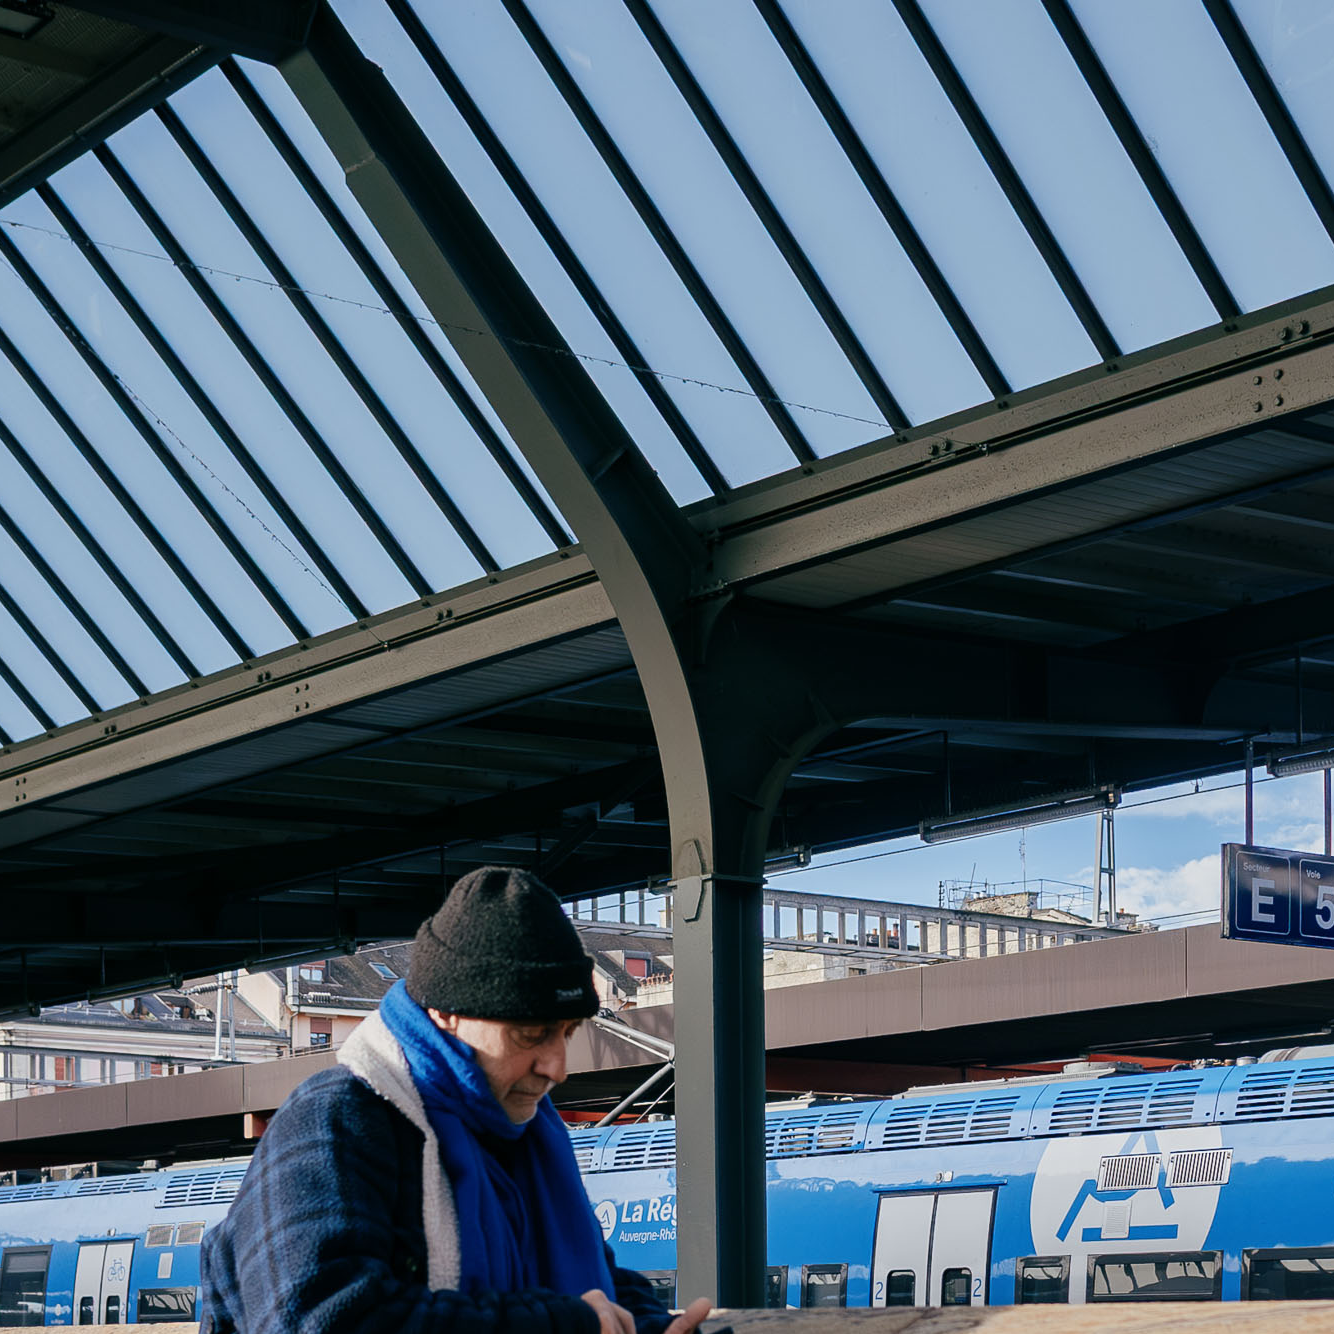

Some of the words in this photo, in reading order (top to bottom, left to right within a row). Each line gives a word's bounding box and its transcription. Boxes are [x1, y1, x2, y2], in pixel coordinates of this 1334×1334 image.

[1243, 862, 1271, 873] Secteur
[1306, 869, 1321, 880] Voie
[1251, 877, 1275, 924] E
[621, 1199, 644, 1223] La
[875, 1281, 884, 1300] 2
[973, 1278, 982, 1297] 2
